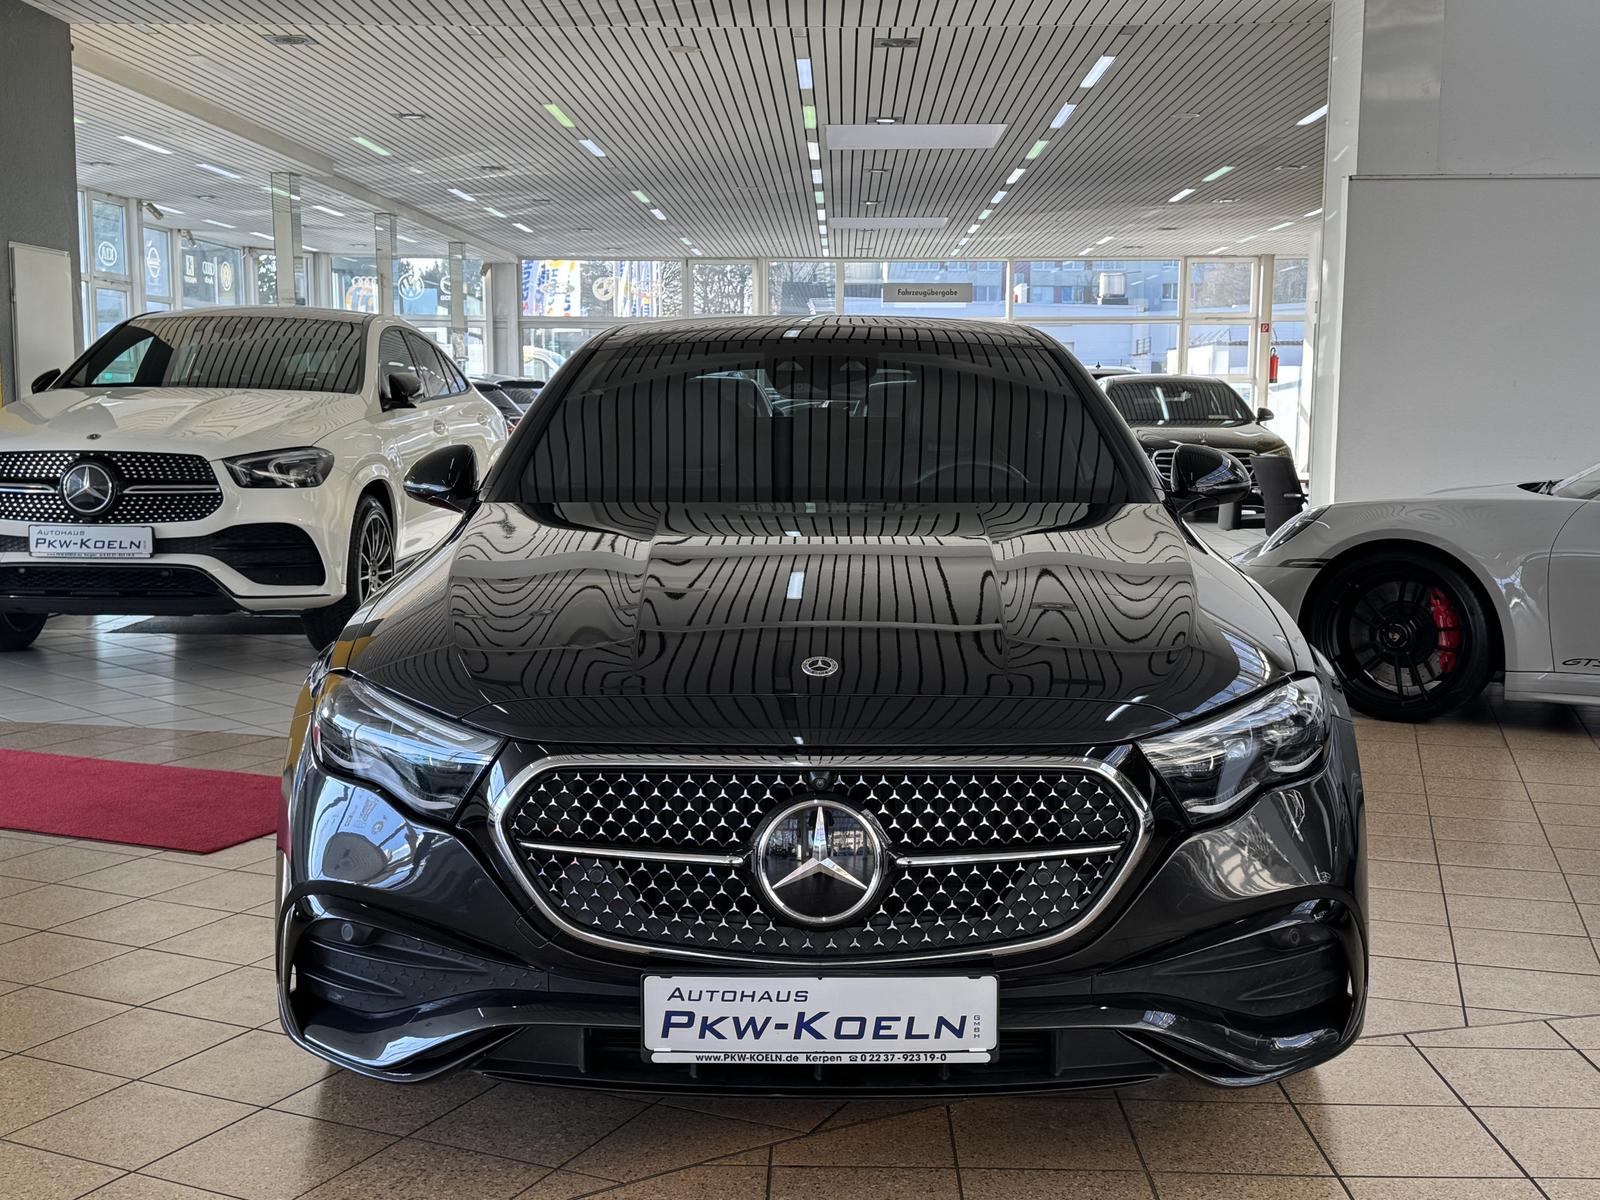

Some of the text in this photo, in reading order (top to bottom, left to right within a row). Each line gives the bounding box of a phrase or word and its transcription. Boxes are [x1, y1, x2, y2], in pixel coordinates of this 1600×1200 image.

[897, 288, 958, 298] Fahrzeugübergabe
[667, 987, 809, 1003] AUTOHAUS
[661, 1010, 967, 1040] PKW-KOELN
[695, 1053, 799, 1063] www.PKW-KOELN.de
[805, 1054, 842, 1064] Kerpen
